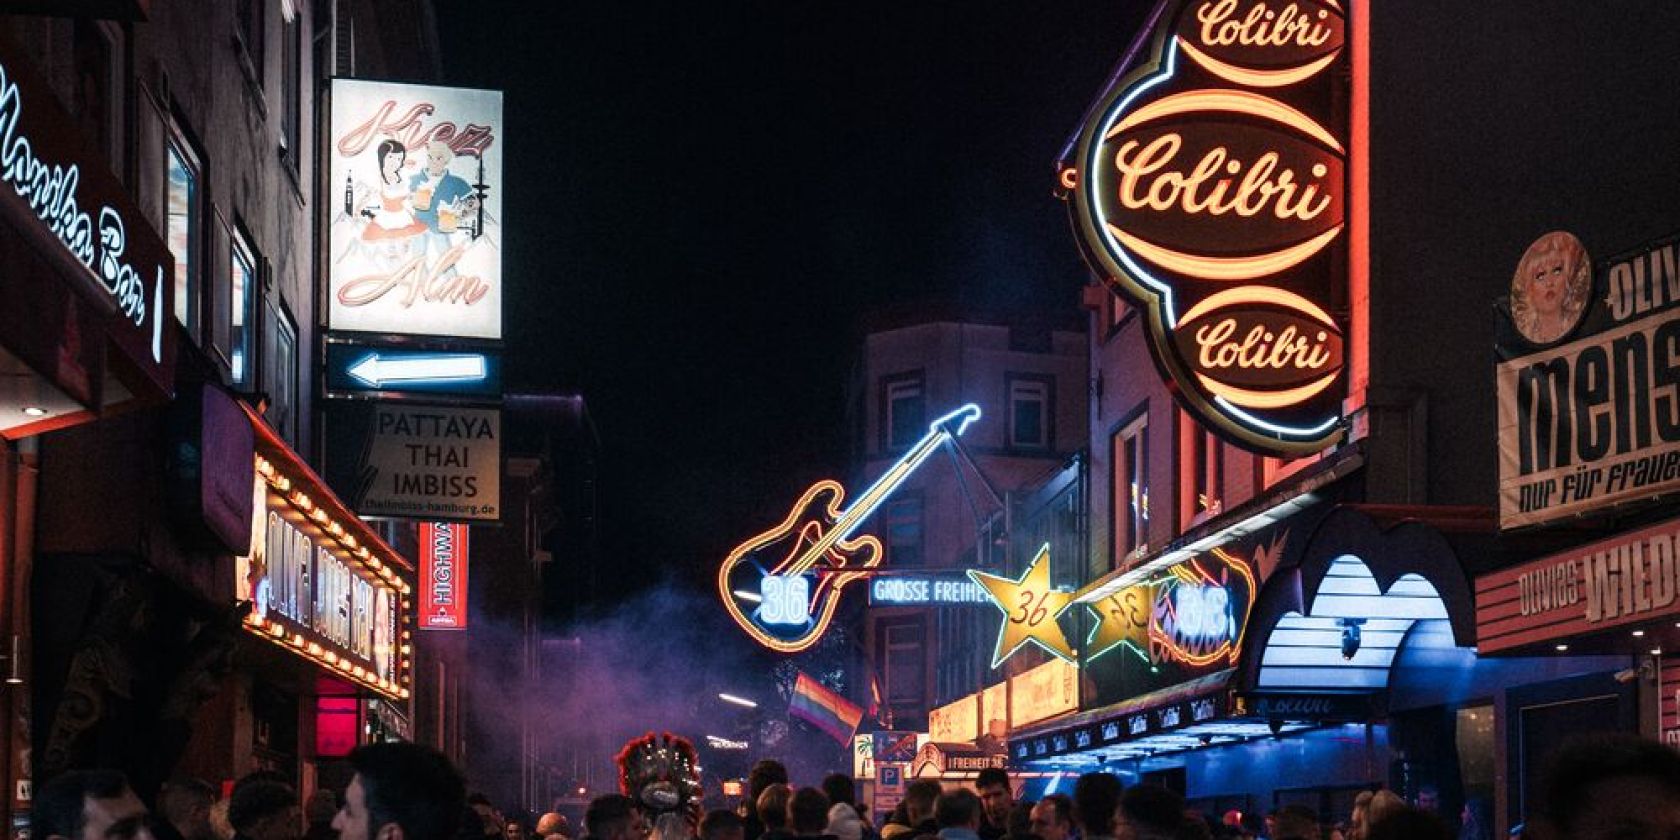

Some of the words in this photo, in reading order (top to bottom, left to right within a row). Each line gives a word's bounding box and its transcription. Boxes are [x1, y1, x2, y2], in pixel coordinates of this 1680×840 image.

[1197, 0, 1331, 46] Colibri
[1115, 133, 1332, 220] Colibri
[99, 206, 145, 327] Bar
[338, 247, 490, 309] Alm
[1196, 318, 1330, 369] Colibri
[379, 412, 493, 439] PATTAYA
[405, 443, 469, 468] THAI
[394, 472, 478, 498] IMBISS
[1519, 479, 1556, 513] nur
[764, 576, 808, 621] 36
[874, 580, 929, 602] GROSSE
[1010, 591, 1048, 627] 36
[885, 768, 895, 784] P
